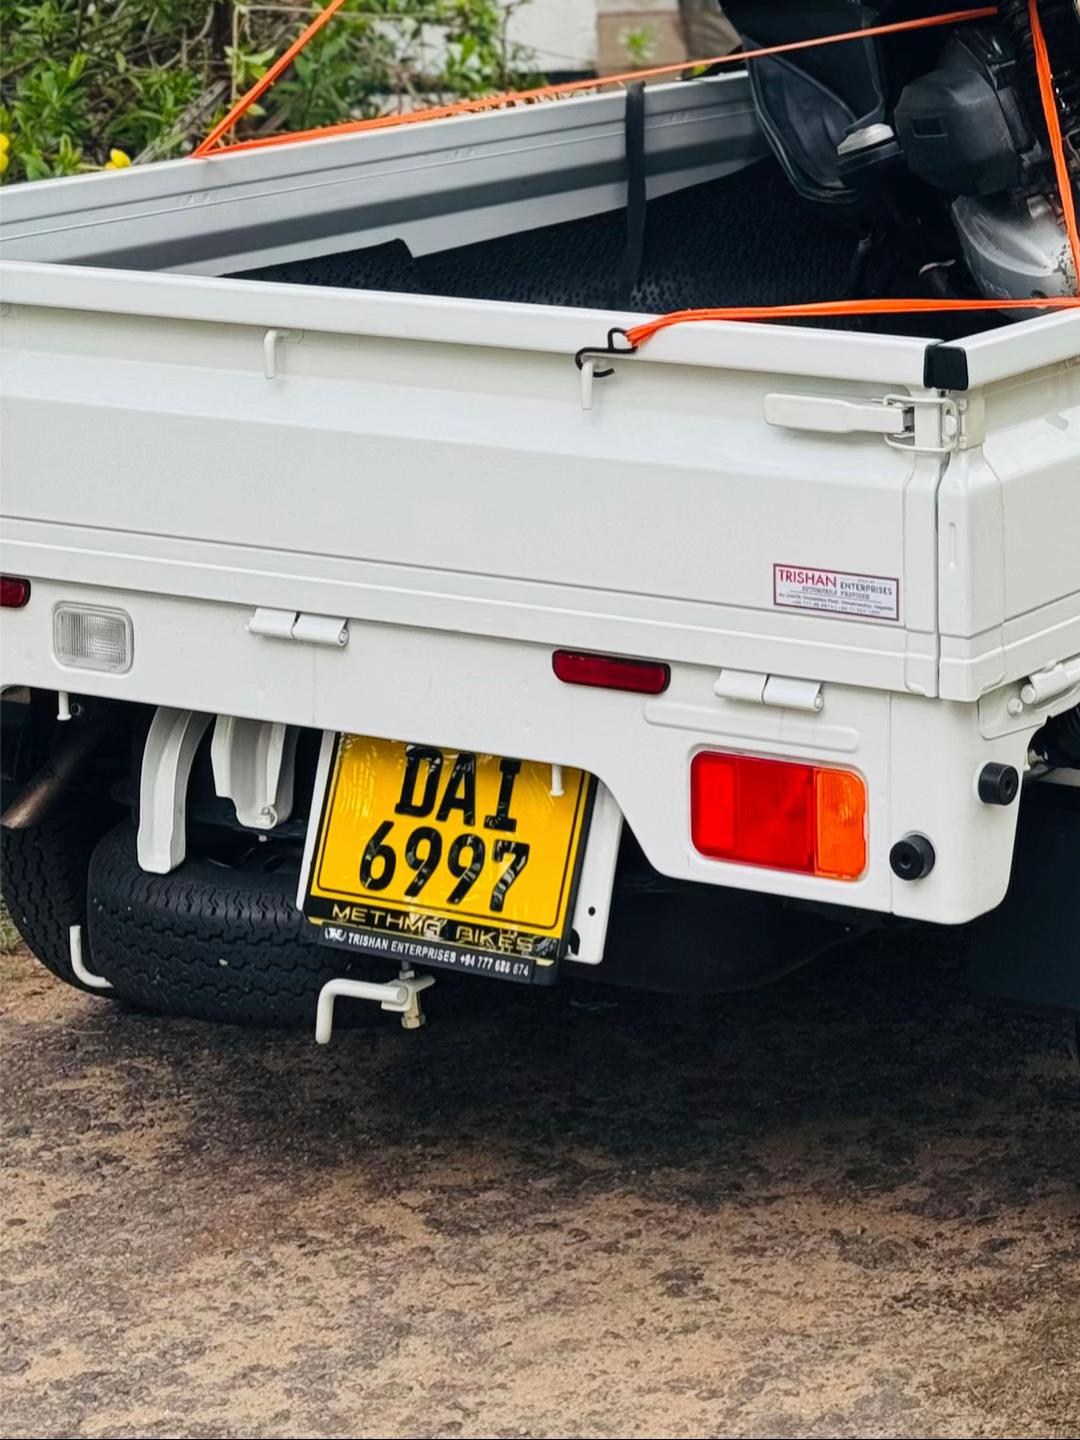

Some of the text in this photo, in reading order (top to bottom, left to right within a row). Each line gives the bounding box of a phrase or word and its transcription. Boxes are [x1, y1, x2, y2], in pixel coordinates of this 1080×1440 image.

[778, 569, 893, 596] TRISHAN ENTERPRISES
[394, 744, 522, 833] DAI
[359, 820, 531, 912] 6997
[348, 932, 389, 950] TRISHAN
[391, 940, 457, 963] ENTERPRISES
[477, 956, 494, 970] 777
[455, 926, 533, 952] BIKES
